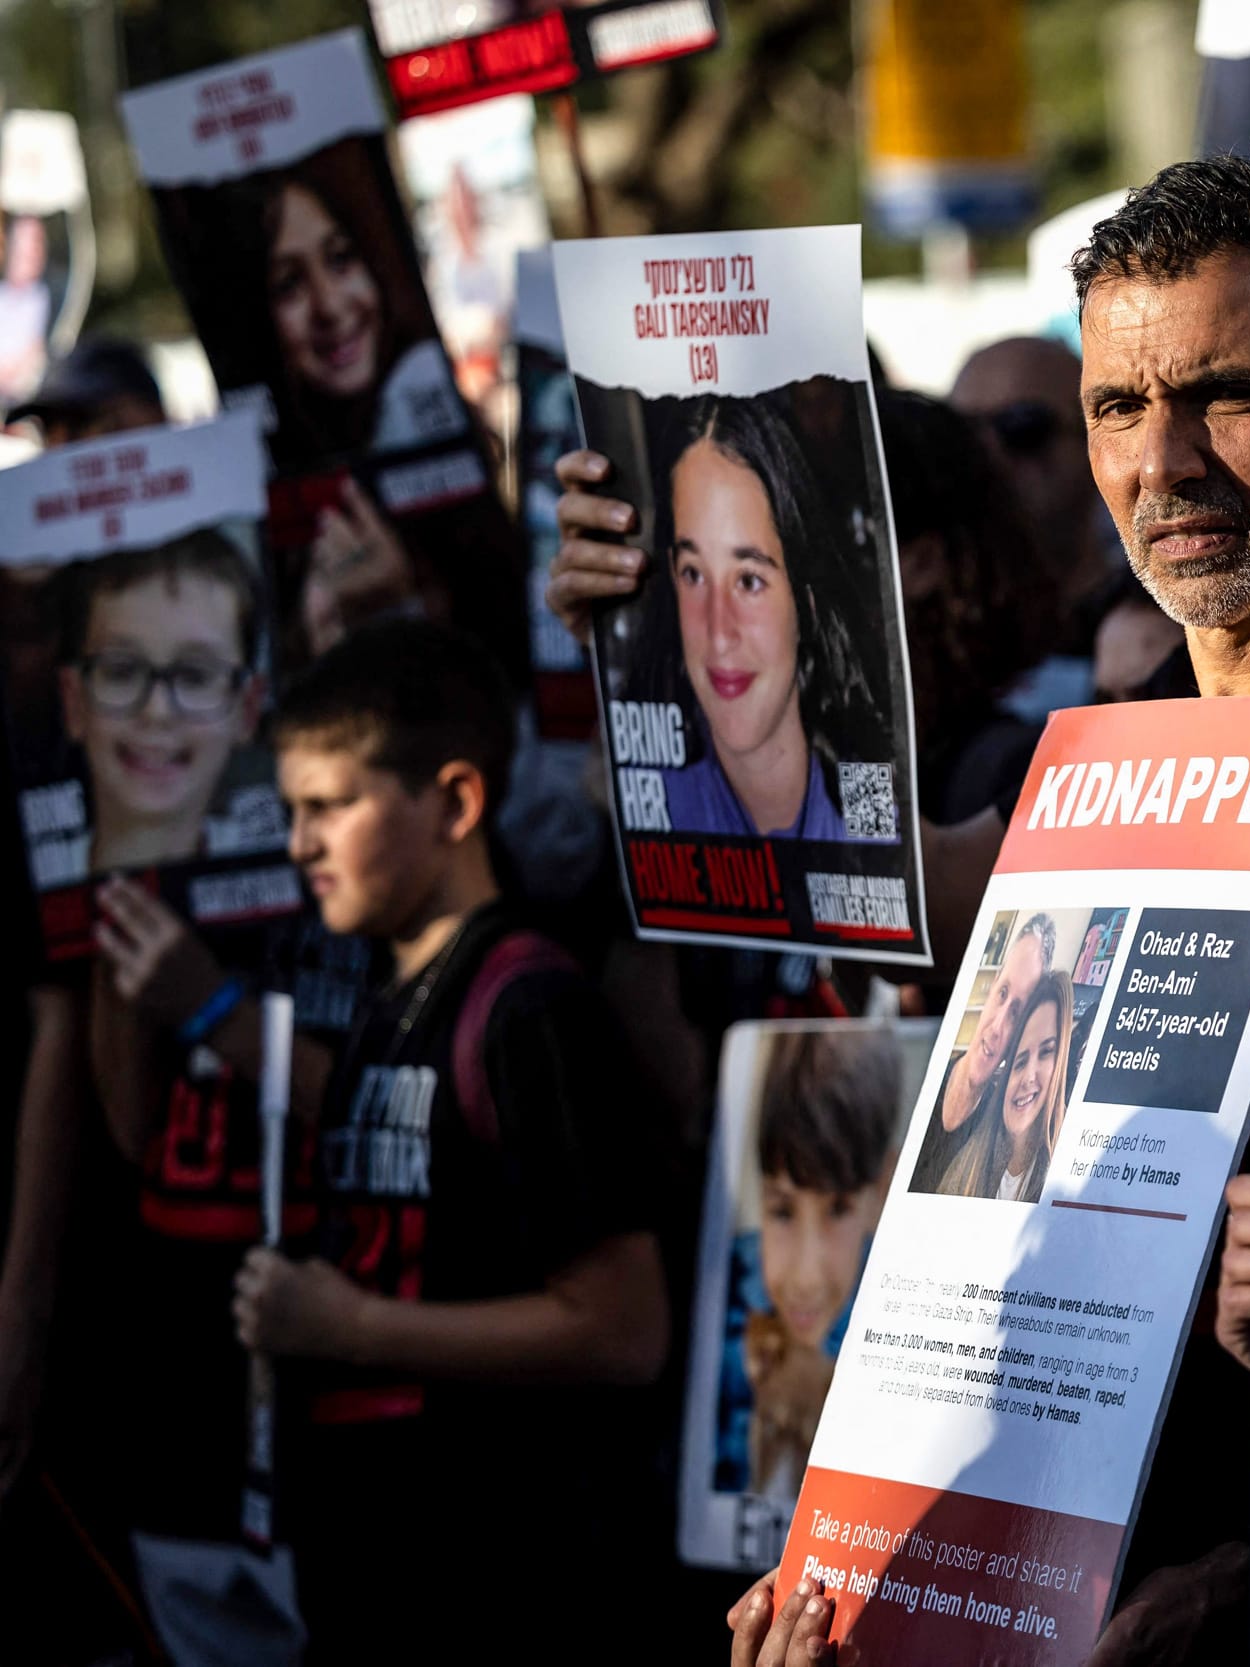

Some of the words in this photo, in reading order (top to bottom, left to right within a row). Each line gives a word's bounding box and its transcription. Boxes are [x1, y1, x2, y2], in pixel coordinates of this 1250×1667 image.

[731, 253, 755, 291] גלי
[634, 302, 668, 339] GALI
[670, 298, 770, 338] TARSHANSKY
[690, 342, 718, 384] (13)
[610, 701, 686, 767] BRING
[618, 767, 672, 832] HER
[628, 839, 706, 903] HOME
[703, 839, 784, 912] NOW!
[1140, 930, 1184, 957] Ohad
[1184, 932, 1198, 957] &
[1200, 933, 1234, 958] Raz
[1127, 968, 1197, 995] Ben-Ami
[1103, 1044, 1160, 1071] Israelis
[1078, 1129, 1138, 1154] Kidnapped
[1139, 1135, 1166, 1154] from
[1071, 1158, 1088, 1177] her
[1090, 1160, 1120, 1181] home
[1121, 1165, 1137, 1186] by
[1139, 1165, 1181, 1186] Hamas
[932, 1302, 952, 1320] Gaza
[953, 1305, 973, 1326] Strip.
[976, 1308, 998, 1327] Their
[998, 1312, 1053, 1334] whereabouts
[1054, 1321, 1086, 1339] remain
[1088, 1326, 1131, 1346] unknown.
[962, 1284, 979, 1300] 200
[980, 1285, 1018, 1306] innocent
[1018, 1289, 1056, 1310] civilians
[1058, 1298, 1081, 1313] were
[1083, 1298, 1131, 1319] abducted
[1131, 1305, 1154, 1323] from
[864, 1328, 883, 1344] More
[883, 1331, 901, 1347] than
[924, 1339, 954, 1356] women,
[956, 1343, 976, 1360] men,
[979, 1345, 997, 1361] and
[997, 1347, 1035, 1369] children,
[1038, 1354, 1073, 1377] ranging
[1075, 1358, 1085, 1374] in
[1085, 1363, 1105, 1381] age
[1106, 1363, 1129, 1381] from
[1130, 1367, 1139, 1383] 3
[922, 1386, 965, 1404] separated
[964, 1389, 984, 1407] from
[984, 1393, 1009, 1412] loved
[1009, 1400, 1032, 1416] ones
[1032, 1401, 1045, 1422] by
[1047, 1403, 1081, 1425] Hamas.
[942, 1367, 963, 1380] were
[963, 1367, 1006, 1389] wounded,
[1007, 1375, 1054, 1396] murdered,
[1056, 1379, 1092, 1403] beaten,
[1094, 1389, 1127, 1408] raped,
[809, 1509, 839, 1541] Take
[840, 1523, 850, 1544] a
[850, 1520, 890, 1553] photo
[892, 1527, 911, 1553] of
[908, 1531, 934, 1561] this
[934, 1542, 985, 1571] poster
[985, 1552, 1019, 1579] and
[1019, 1556, 1066, 1590] share
[1069, 1564, 1083, 1594] it
[801, 1554, 846, 1590] Please
[847, 1565, 879, 1603] help
[880, 1572, 919, 1614] bring
[922, 1587, 963, 1622] them
[964, 1592, 1010, 1628] home
[1013, 1605, 1059, 1640] alive.
